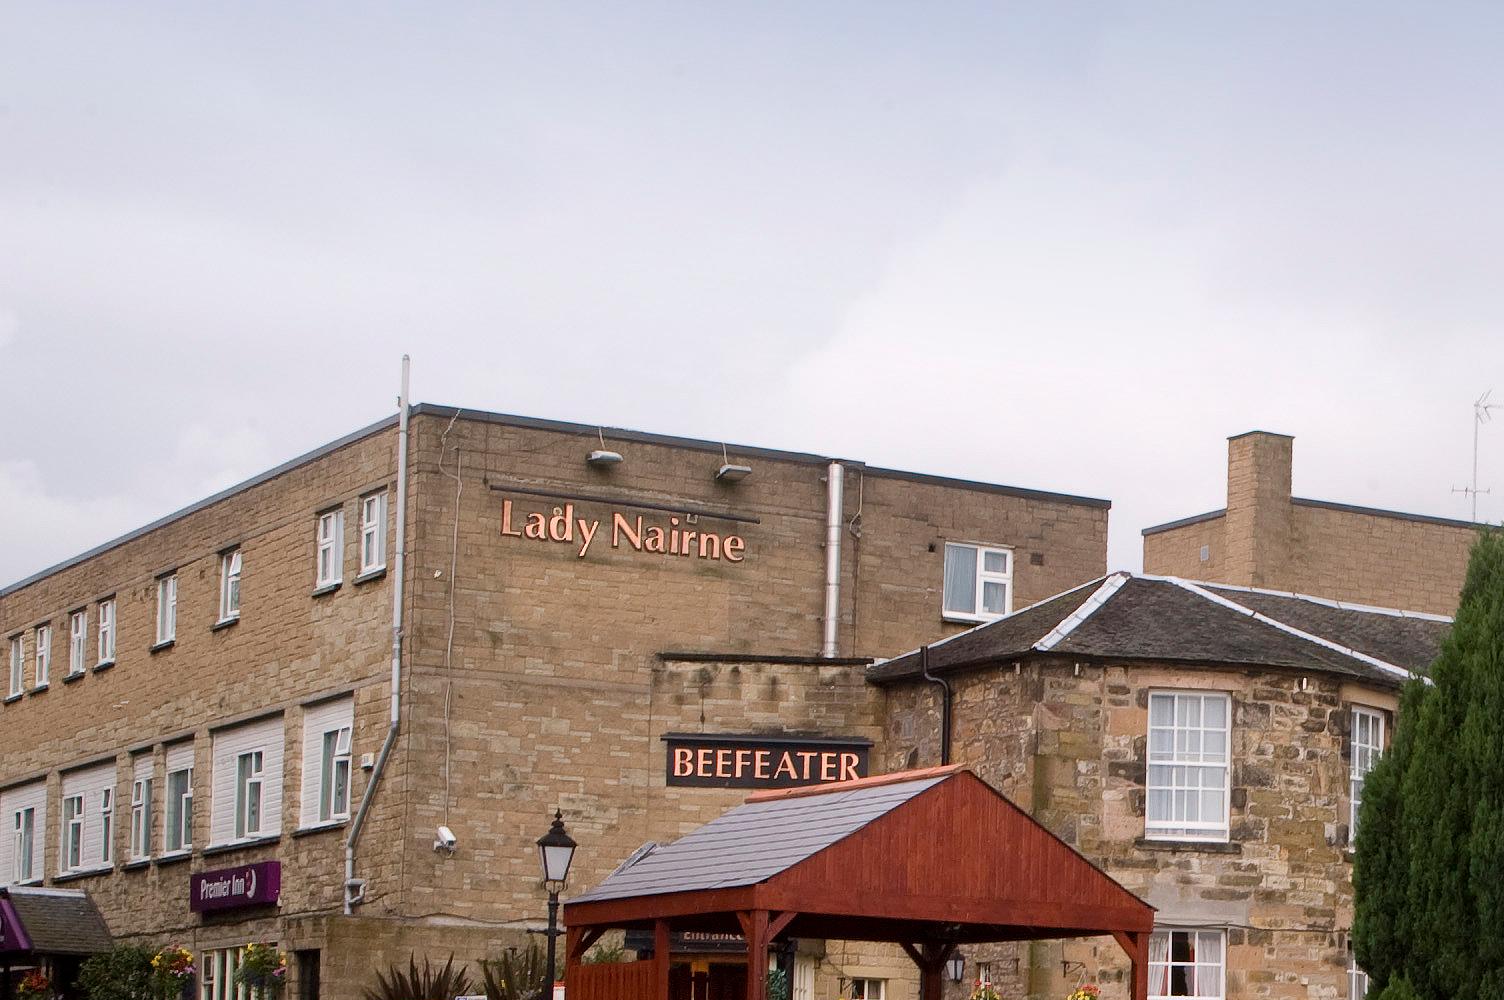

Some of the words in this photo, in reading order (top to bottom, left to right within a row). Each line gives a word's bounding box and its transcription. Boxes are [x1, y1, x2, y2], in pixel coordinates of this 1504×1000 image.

[501, 499, 599, 557] Lady
[611, 511, 746, 563] Nairne
[673, 747, 861, 781] BEEFEATER
[200, 876, 231, 900] Premier
[232, 874, 245, 896] Inn
